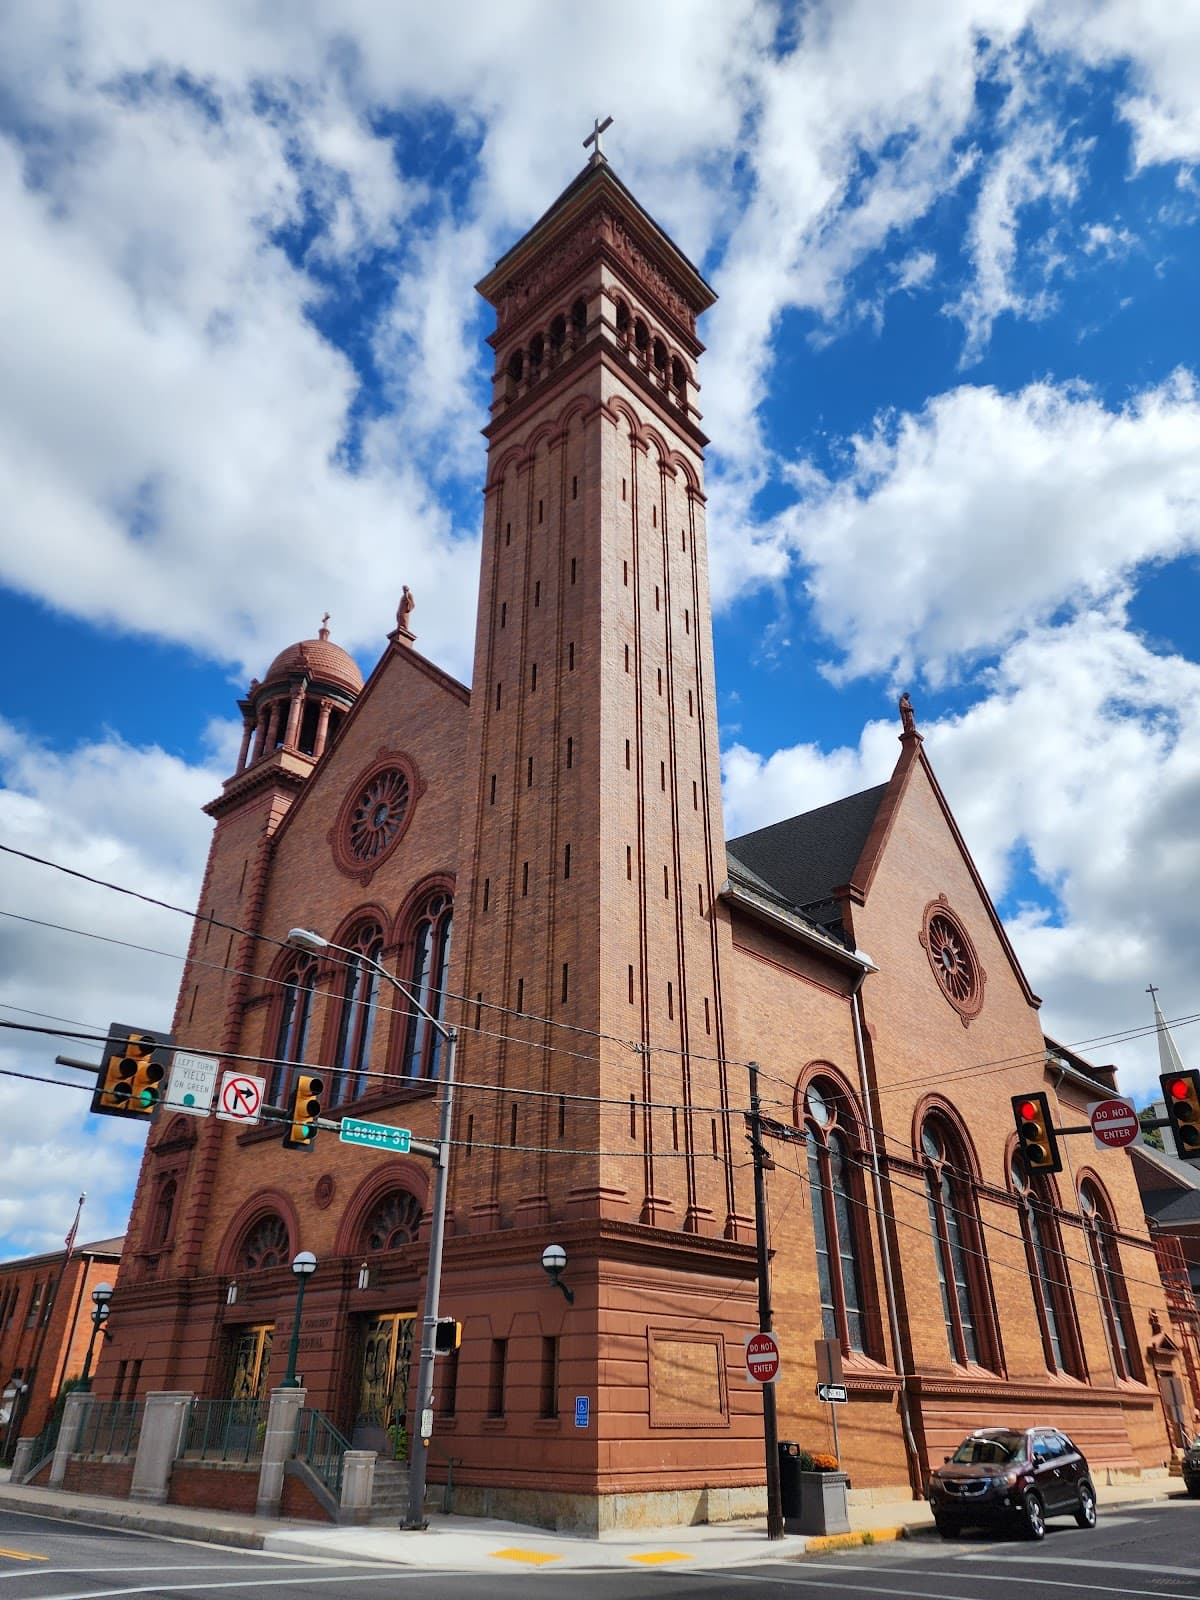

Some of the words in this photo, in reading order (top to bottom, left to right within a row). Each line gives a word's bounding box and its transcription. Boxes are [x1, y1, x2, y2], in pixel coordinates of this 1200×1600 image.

[177, 1057, 194, 1067] LEFT
[198, 1062, 214, 1071] TURN
[183, 1071, 206, 1081] YIELD
[174, 1080, 184, 1089] ON
[187, 1083, 209, 1093] GREEN
[1095, 1111, 1108, 1120] DO
[1112, 1108, 1129, 1118] NOT
[346, 1121, 388, 1143] Locust
[392, 1131, 406, 1147] St
[1103, 1129, 1131, 1140] ENTER
[750, 1344, 759, 1353] DO
[761, 1342, 773, 1352] NOT
[753, 1364, 773, 1373] ENTER
